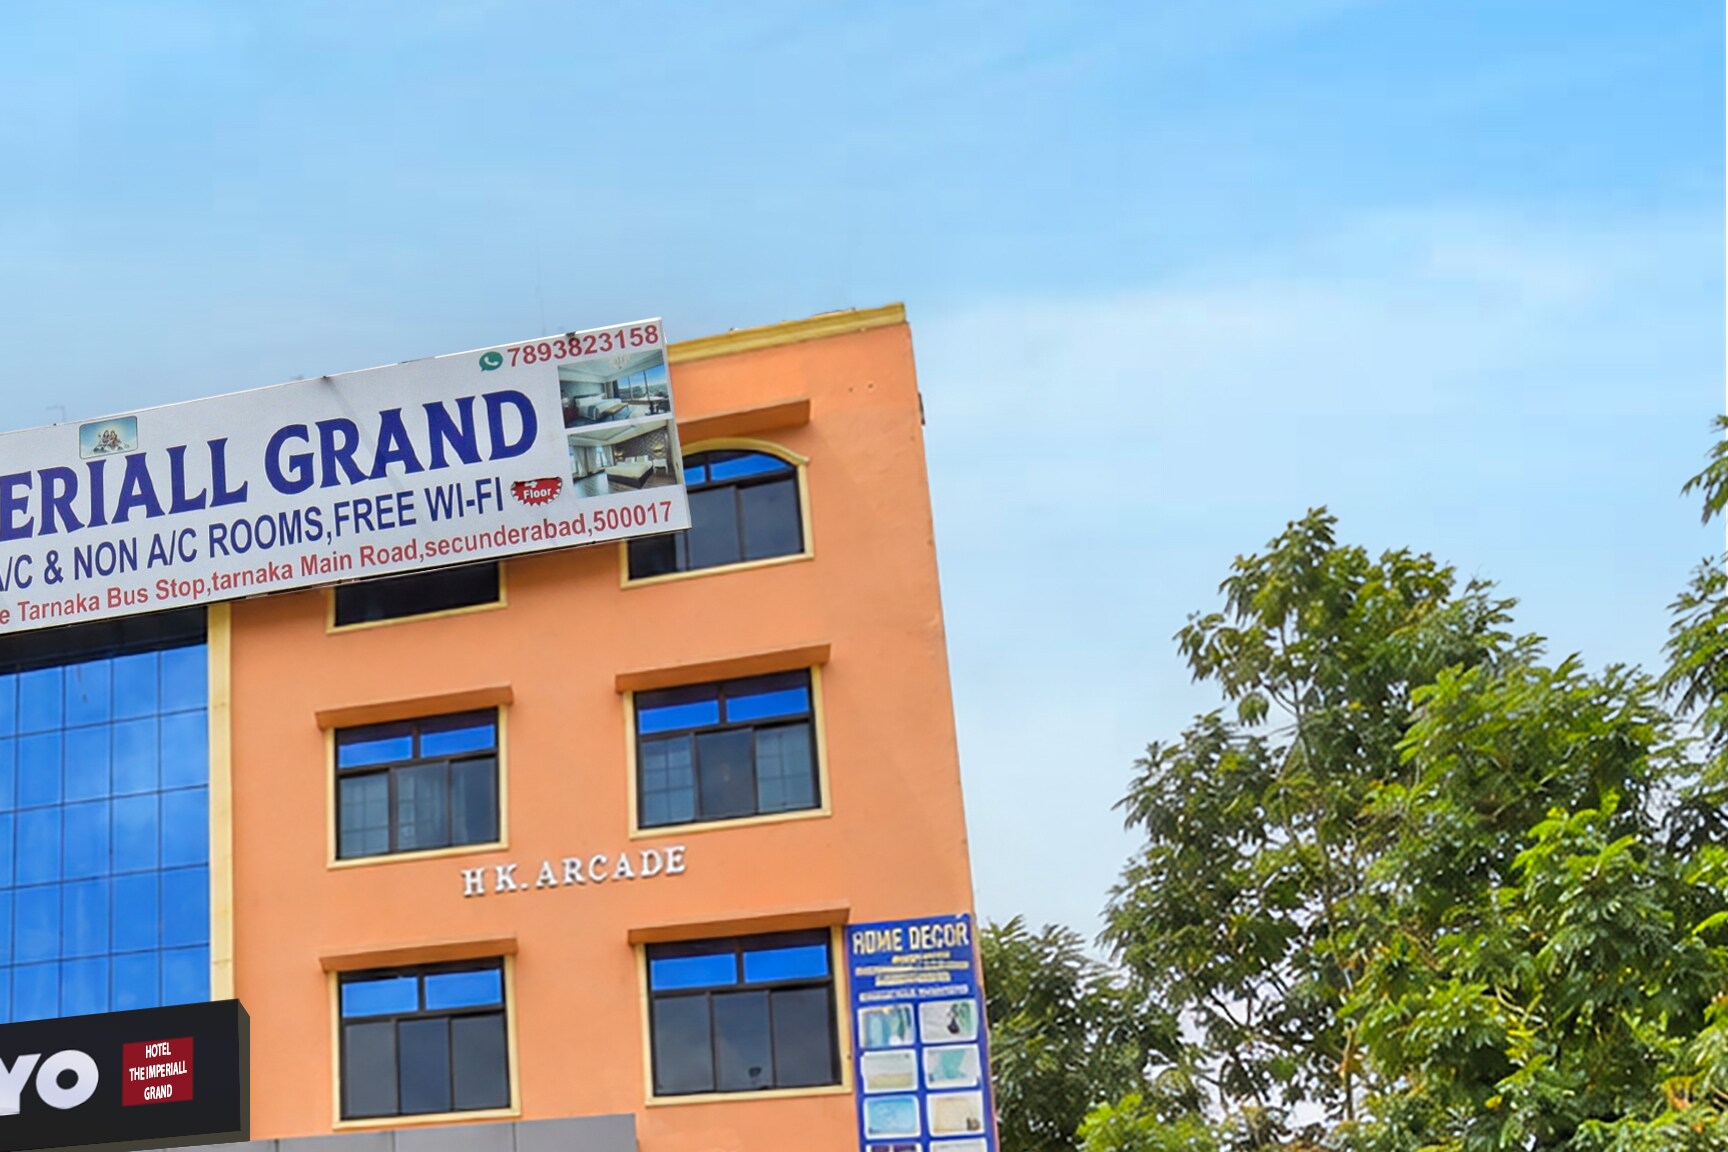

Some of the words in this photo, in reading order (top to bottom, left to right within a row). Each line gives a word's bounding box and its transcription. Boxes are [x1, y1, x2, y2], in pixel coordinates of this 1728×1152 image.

[507, 324, 659, 367] 7893823158
[264, 390, 538, 495] GRAND
[523, 488, 551, 500] Floor
[44, 550, 63, 585] &
[74, 537, 138, 579] NON
[147, 528, 198, 568] A/C
[428, 477, 504, 522] WI-FI
[18, 596, 100, 623] Tarnaka
[106, 586, 149, 609] Bus
[301, 549, 353, 577] Main
[853, 928, 902, 954] HOME
[909, 922, 969, 950] DECOR
[145, 1042, 171, 1059] HOTEL
[129, 1067, 145, 1081] THE
[146, 1060, 187, 1079] IMPERIALL
[144, 1085, 173, 1100] GRAND
